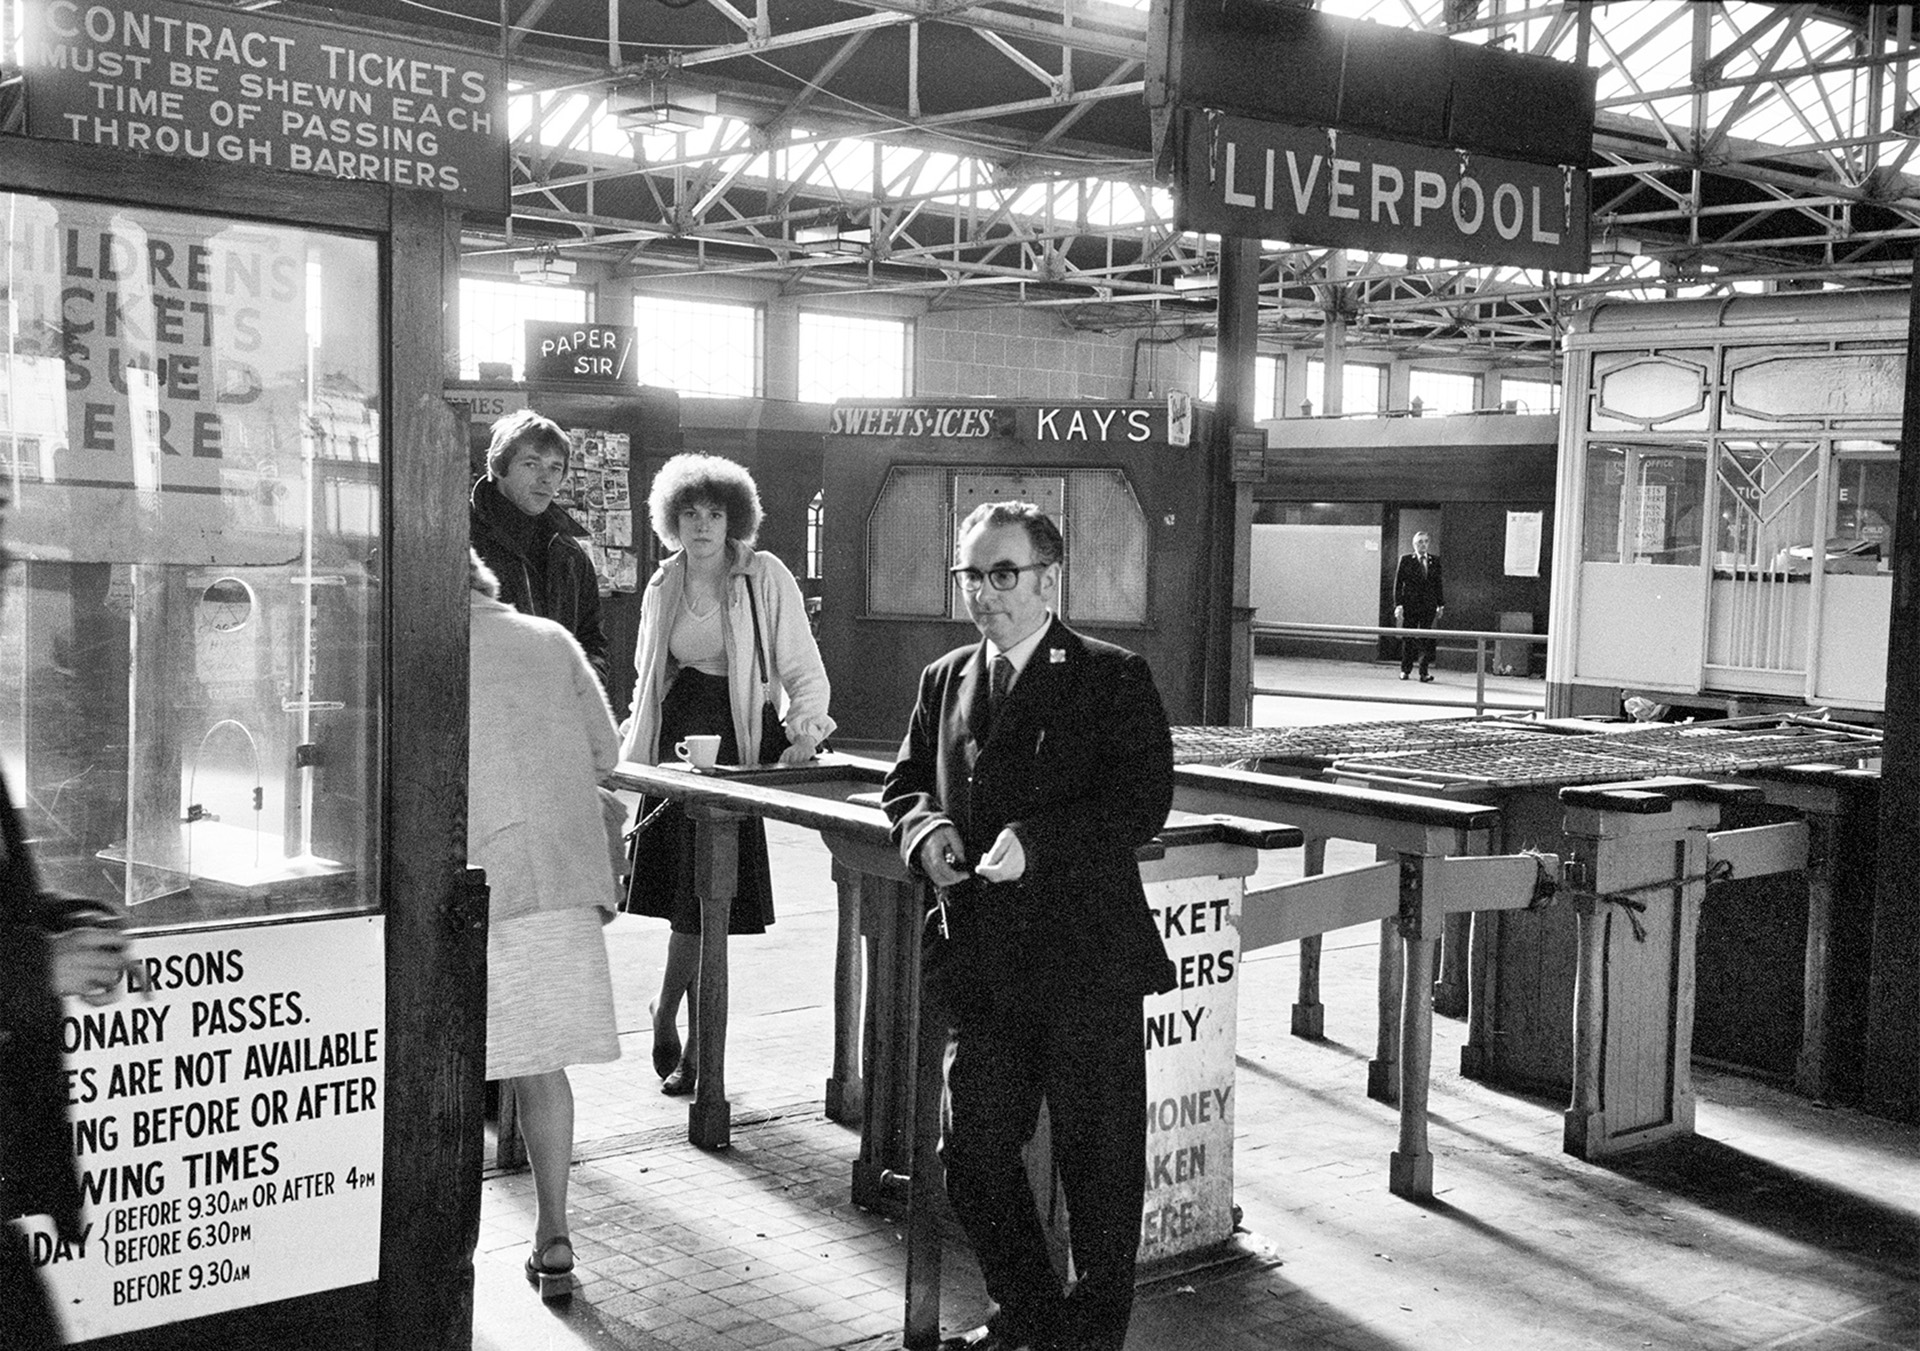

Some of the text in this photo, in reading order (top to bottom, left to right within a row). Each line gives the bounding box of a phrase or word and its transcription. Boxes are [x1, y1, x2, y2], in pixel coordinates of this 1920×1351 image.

[47, 0, 487, 104] CONTRACT TICKETS
[40, 42, 492, 135] MUST BE SHEWN EACH
[89, 81, 439, 157] TIME OF PASSING
[63, 113, 468, 193] THROUGH BARRIERS.
[1223, 141, 1560, 246] LIVERPOOL
[541, 329, 616, 357] PAPER
[1036, 408, 1152, 442] KAY'S
[126, 949, 244, 994] ERSONS
[1180, 949, 1234, 990] ERS
[60, 991, 312, 1055] ONARY PASSES.
[1145, 1006, 1206, 1051] NLY
[107, 1058, 164, 1100] ARE
[175, 1049, 233, 1090] NOT
[243, 1028, 379, 1081] AVAILABLE
[132, 1096, 241, 1148] BEFORE
[250, 1089, 289, 1128] OR
[295, 1076, 377, 1123] AFTER
[182, 1141, 280, 1190] TIMES
[114, 1198, 182, 1234] BEFORE
[252, 1183, 278, 1208] OR
[282, 1171, 335, 1204] AFTER
[114, 1229, 182, 1266] BEFORE
[113, 1268, 183, 1306] BEFORE
